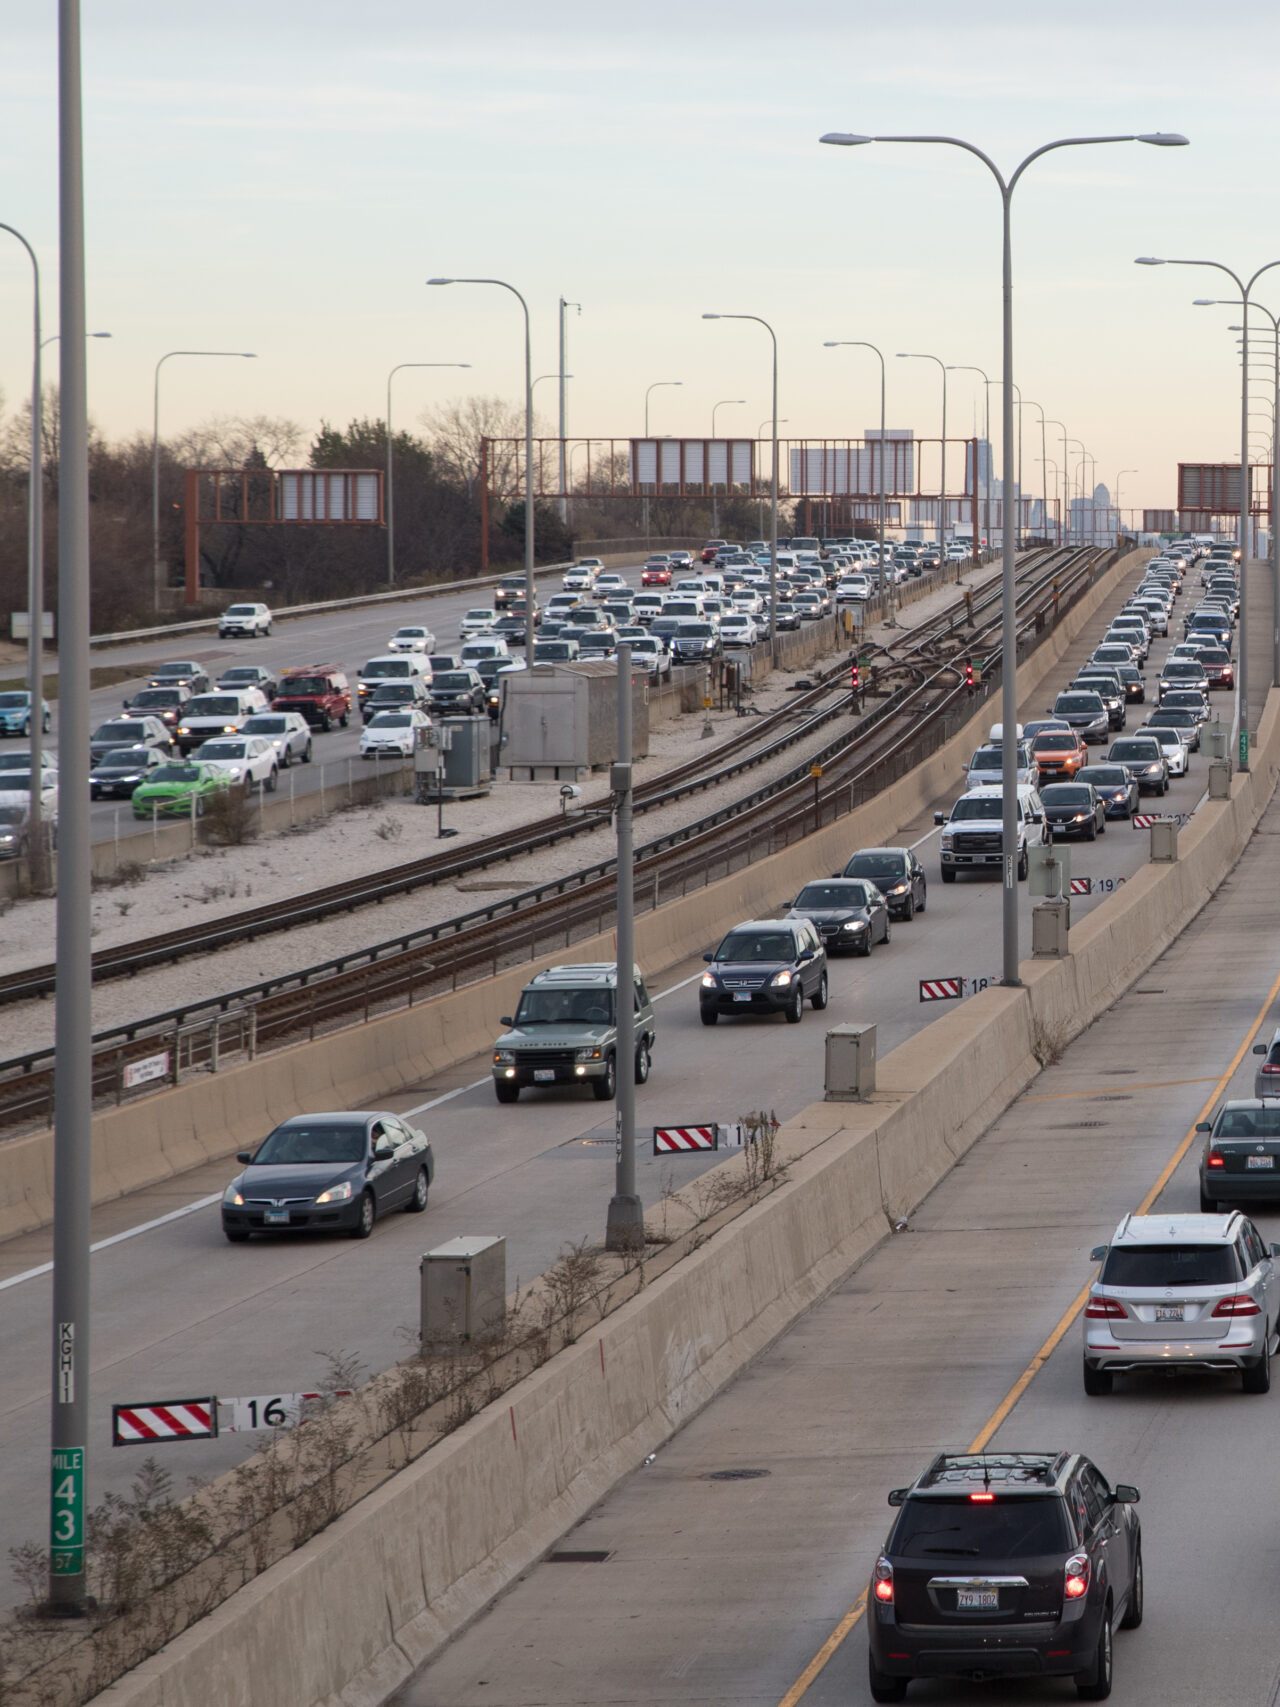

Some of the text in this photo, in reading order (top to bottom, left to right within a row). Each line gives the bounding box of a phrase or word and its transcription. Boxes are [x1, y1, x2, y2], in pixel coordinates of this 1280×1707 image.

[1099, 879, 1113, 892] 19
[972, 978, 988, 994] 18
[248, 1398, 286, 1428] 16
[52, 1453, 82, 1470] MILE
[960, 1594, 996, 1606] ZY9 1802
